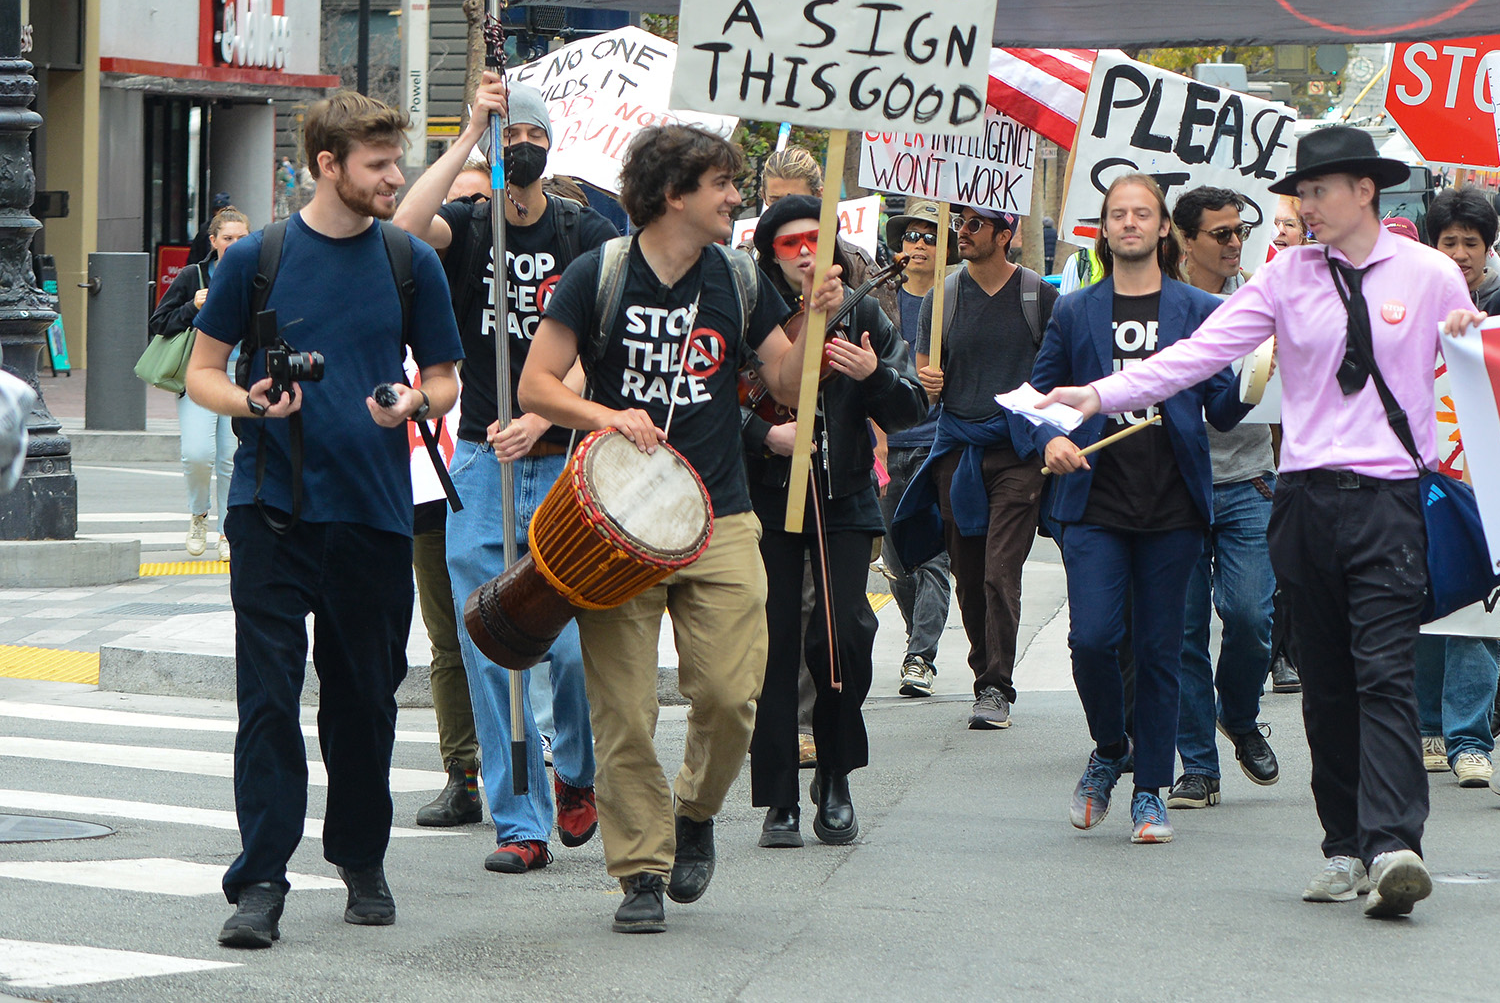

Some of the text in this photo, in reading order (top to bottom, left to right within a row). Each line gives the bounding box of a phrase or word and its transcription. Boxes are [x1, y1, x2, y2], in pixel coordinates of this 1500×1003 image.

[541, 49, 583, 86] NO
[591, 38, 668, 72] ONE
[600, 69, 638, 98] IT
[693, 42, 983, 126] THIS GOOD
[1395, 42, 1497, 114] STO
[410, 70, 421, 113] Powell
[1091, 64, 1297, 181] PLEASE
[869, 145, 1023, 211] WON'T WORK
[622, 338, 682, 373] THE
[621, 368, 712, 406] RACE
